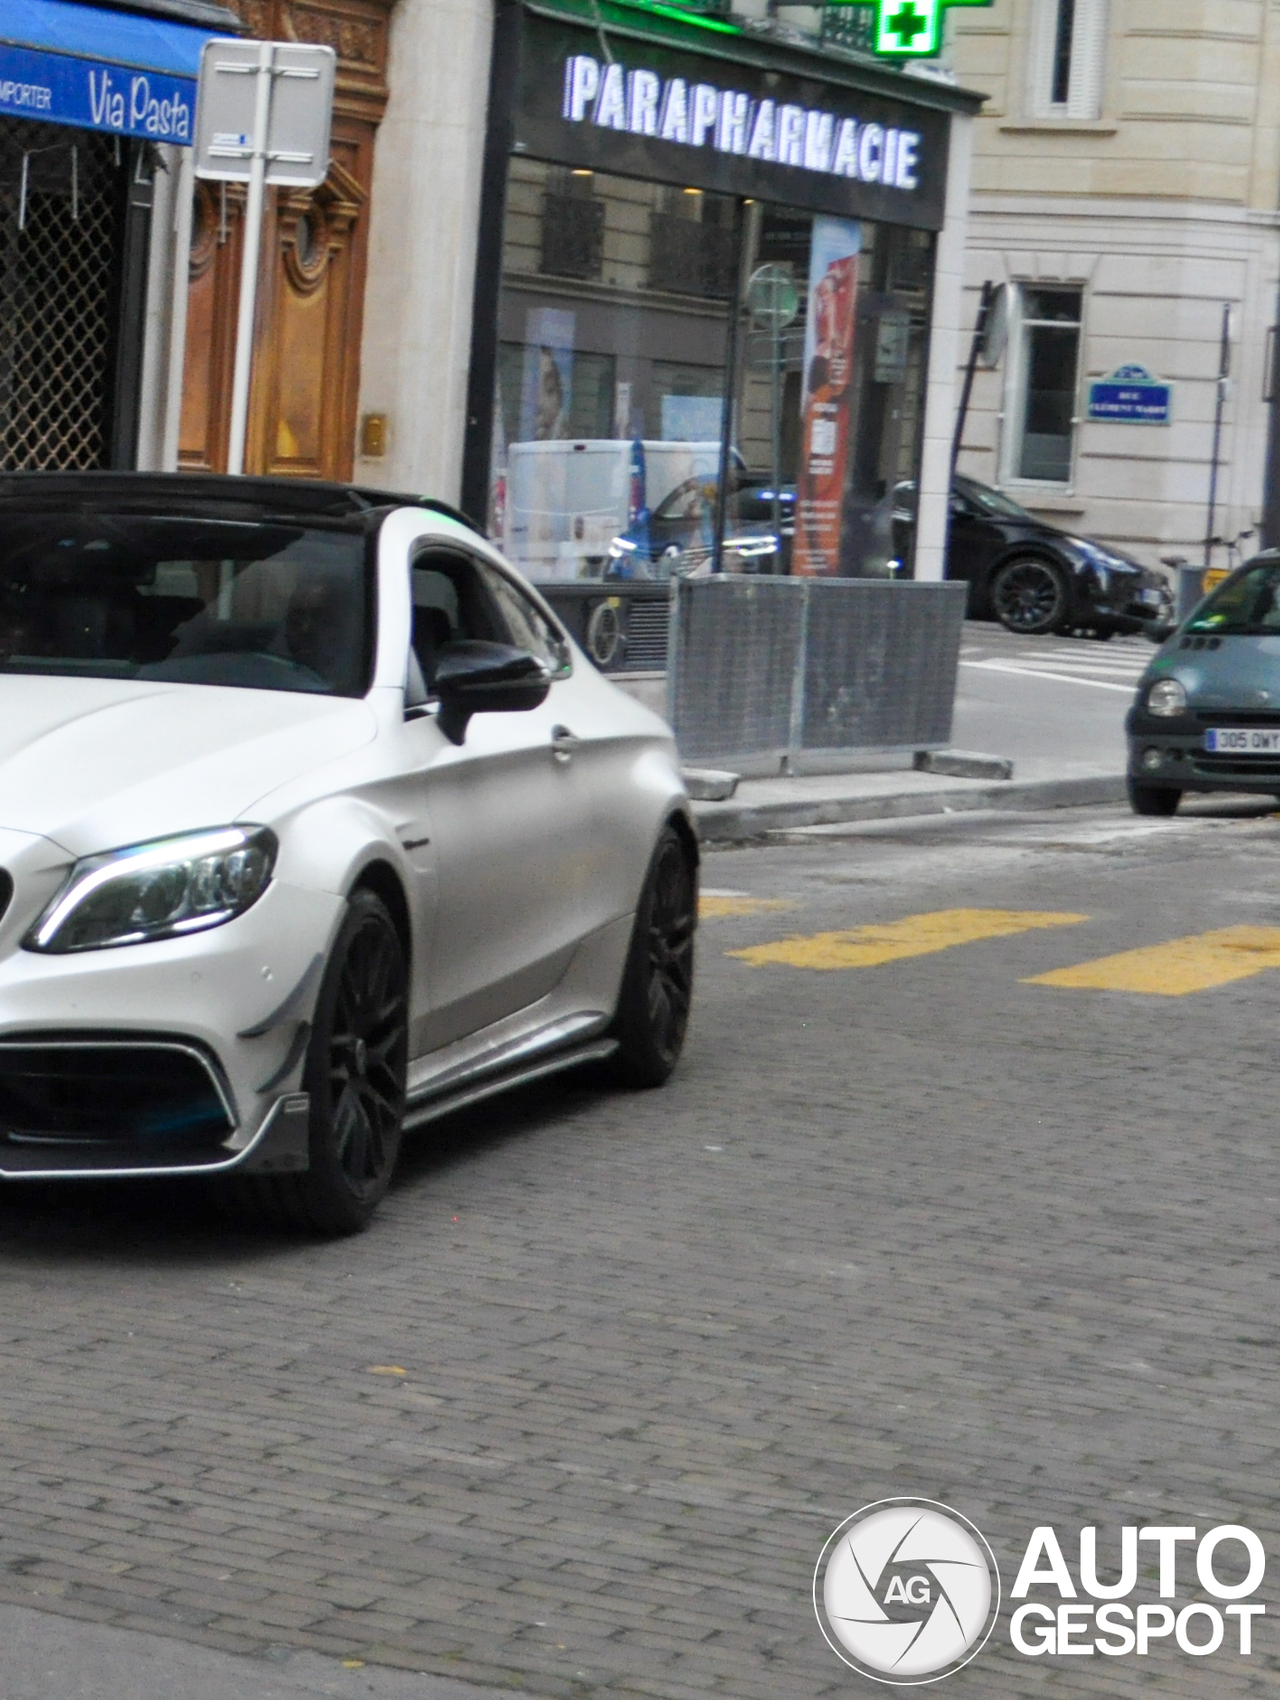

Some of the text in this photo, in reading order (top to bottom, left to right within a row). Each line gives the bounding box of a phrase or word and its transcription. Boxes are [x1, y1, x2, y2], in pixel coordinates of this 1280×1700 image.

[89, 69, 190, 138] Via Pasta
[562, 55, 920, 190] PARAPHARMACIE
[1220, 731, 1247, 749] 305
